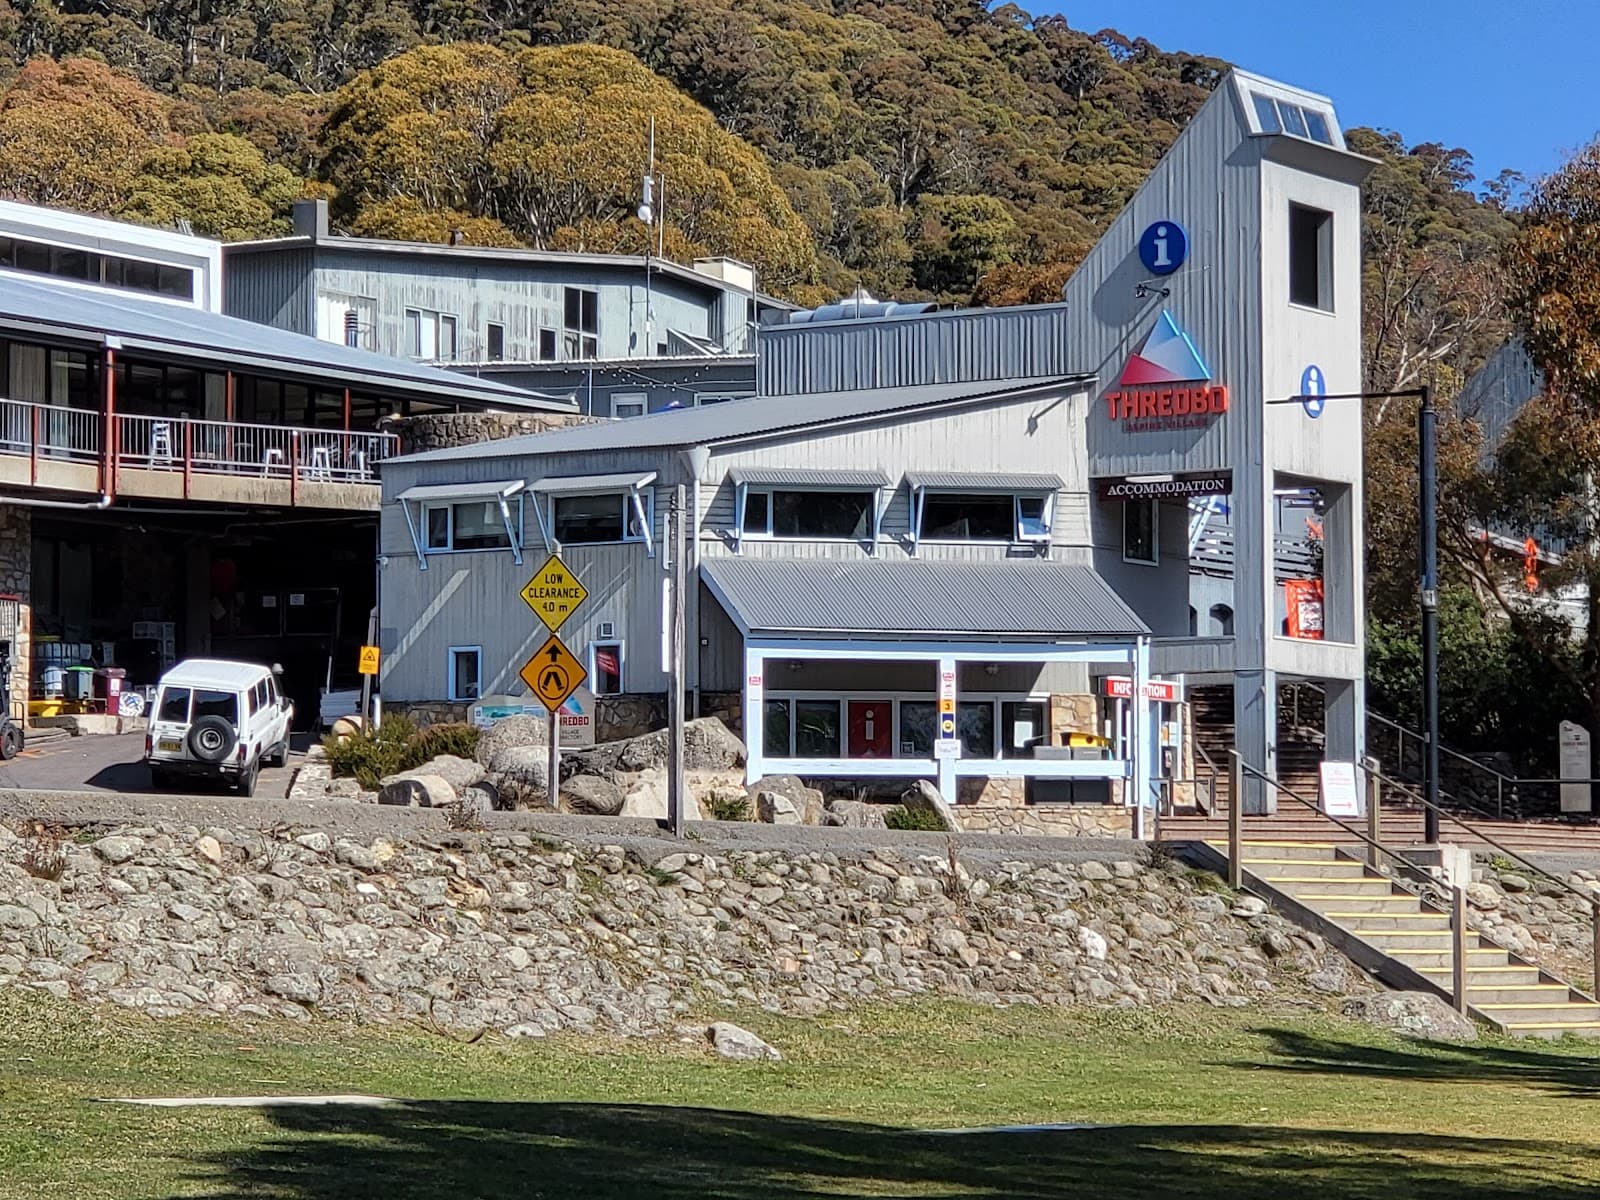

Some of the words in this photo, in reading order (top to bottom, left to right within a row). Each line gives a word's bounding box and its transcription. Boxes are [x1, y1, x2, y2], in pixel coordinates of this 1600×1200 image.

[1104, 385, 1228, 421] THREDBO
[1106, 479, 1225, 496] ACCOMMODATION
[545, 574, 563, 584] LOW
[528, 588, 580, 598] CLEARANCE
